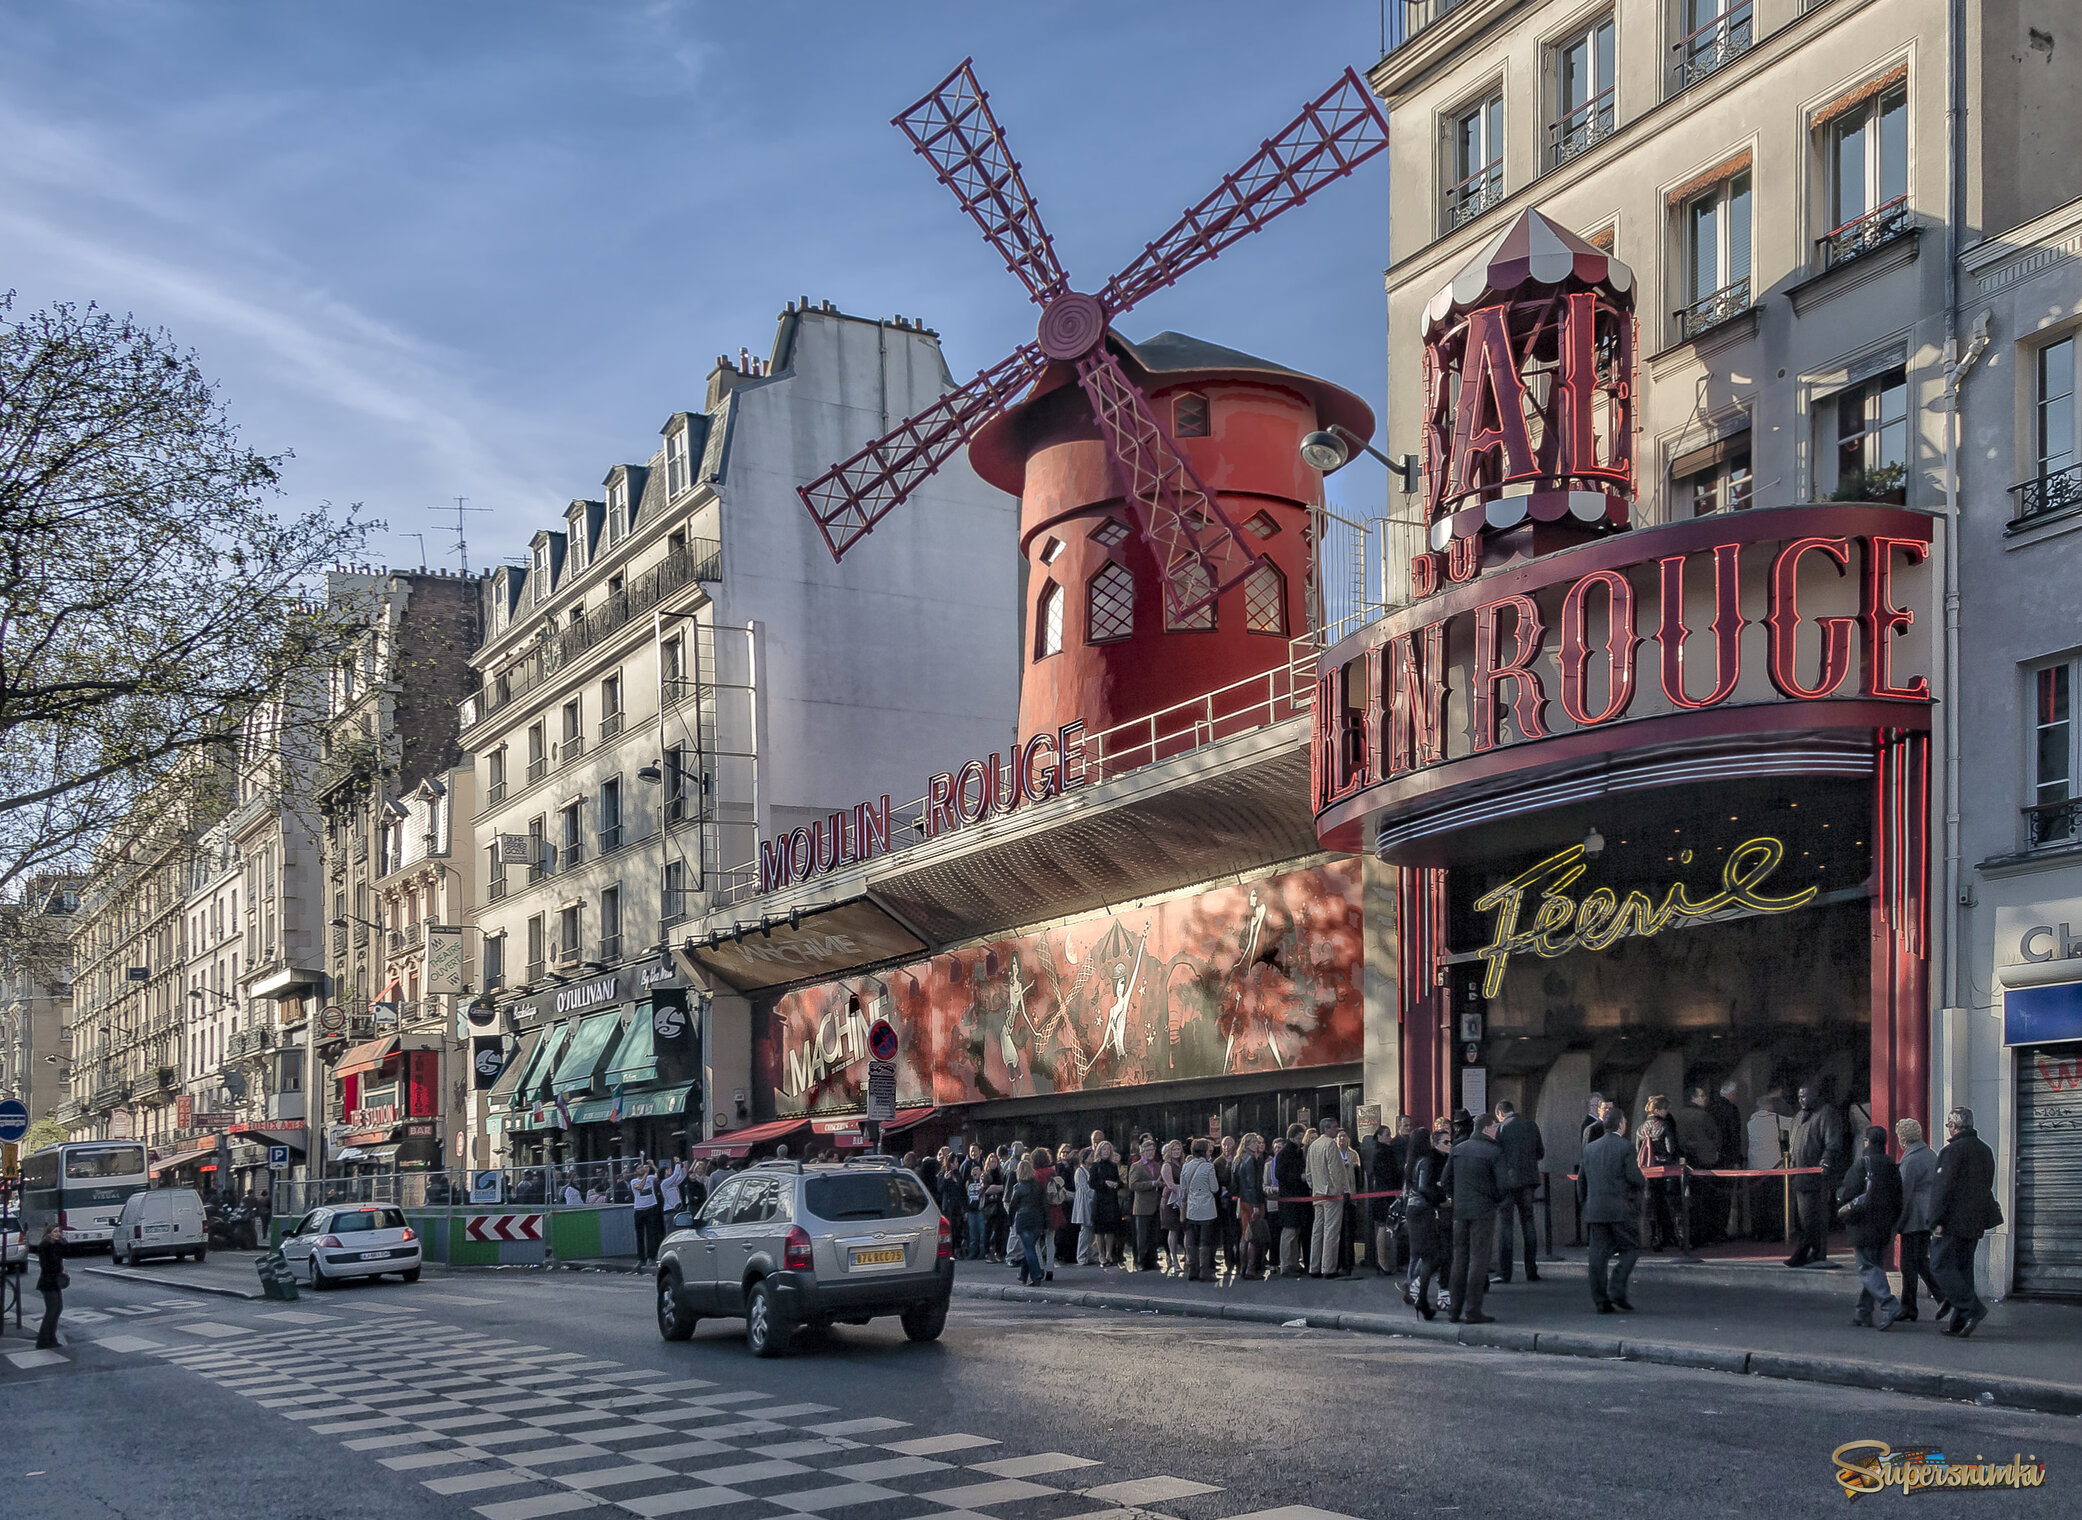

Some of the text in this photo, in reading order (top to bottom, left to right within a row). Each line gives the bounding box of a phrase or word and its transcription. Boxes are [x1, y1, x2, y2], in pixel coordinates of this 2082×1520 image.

[1473, 536, 1931, 753] ROUGE
[761, 718, 1088, 893] MOULIN ROUGE
[1473, 837, 1819, 1000] Féerie
[430, 959, 462, 981] OUVERT
[556, 977, 617, 1013] O'SULLIVANS
[409, 1126, 433, 1137] BAR
[274, 1151, 284, 1161] P
